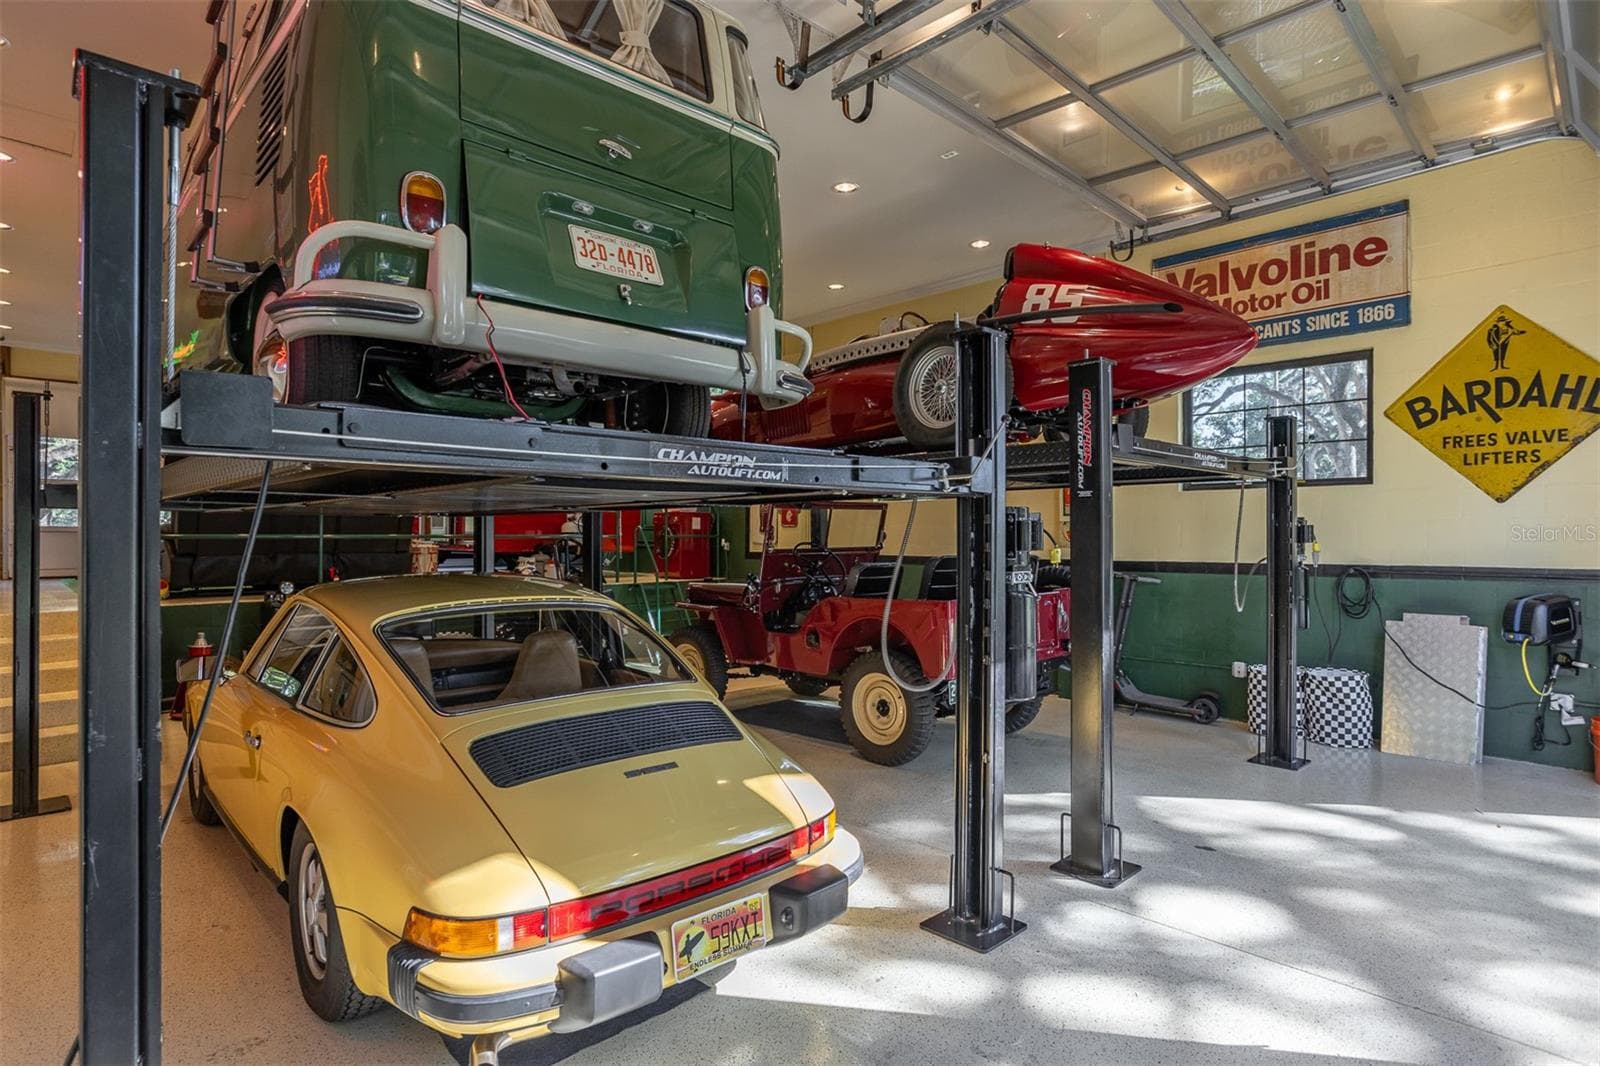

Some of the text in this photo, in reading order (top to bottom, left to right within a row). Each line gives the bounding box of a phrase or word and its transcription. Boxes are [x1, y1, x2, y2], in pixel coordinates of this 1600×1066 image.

[595, 261, 643, 279] FLORIDA
[1166, 236, 1389, 298] Valvoline
[1020, 284, 1088, 323] 85
[1291, 278, 1330, 305] Oil
[1256, 303, 1395, 340] CANTS SINCE 1866
[1405, 369, 1600, 430] BARDAHL
[1442, 428, 1569, 449] FREES VALVE
[657, 447, 756, 467] CHAMPION
[1463, 449, 1541, 466] LIFTERS
[687, 465, 782, 481] AUTOLIFT.COM
[590, 847, 791, 921] PORSCHE
[701, 906, 737, 925] FLORIDA
[710, 911, 760, 954] 59KXI
[689, 951, 722, 971] ENDLESS
